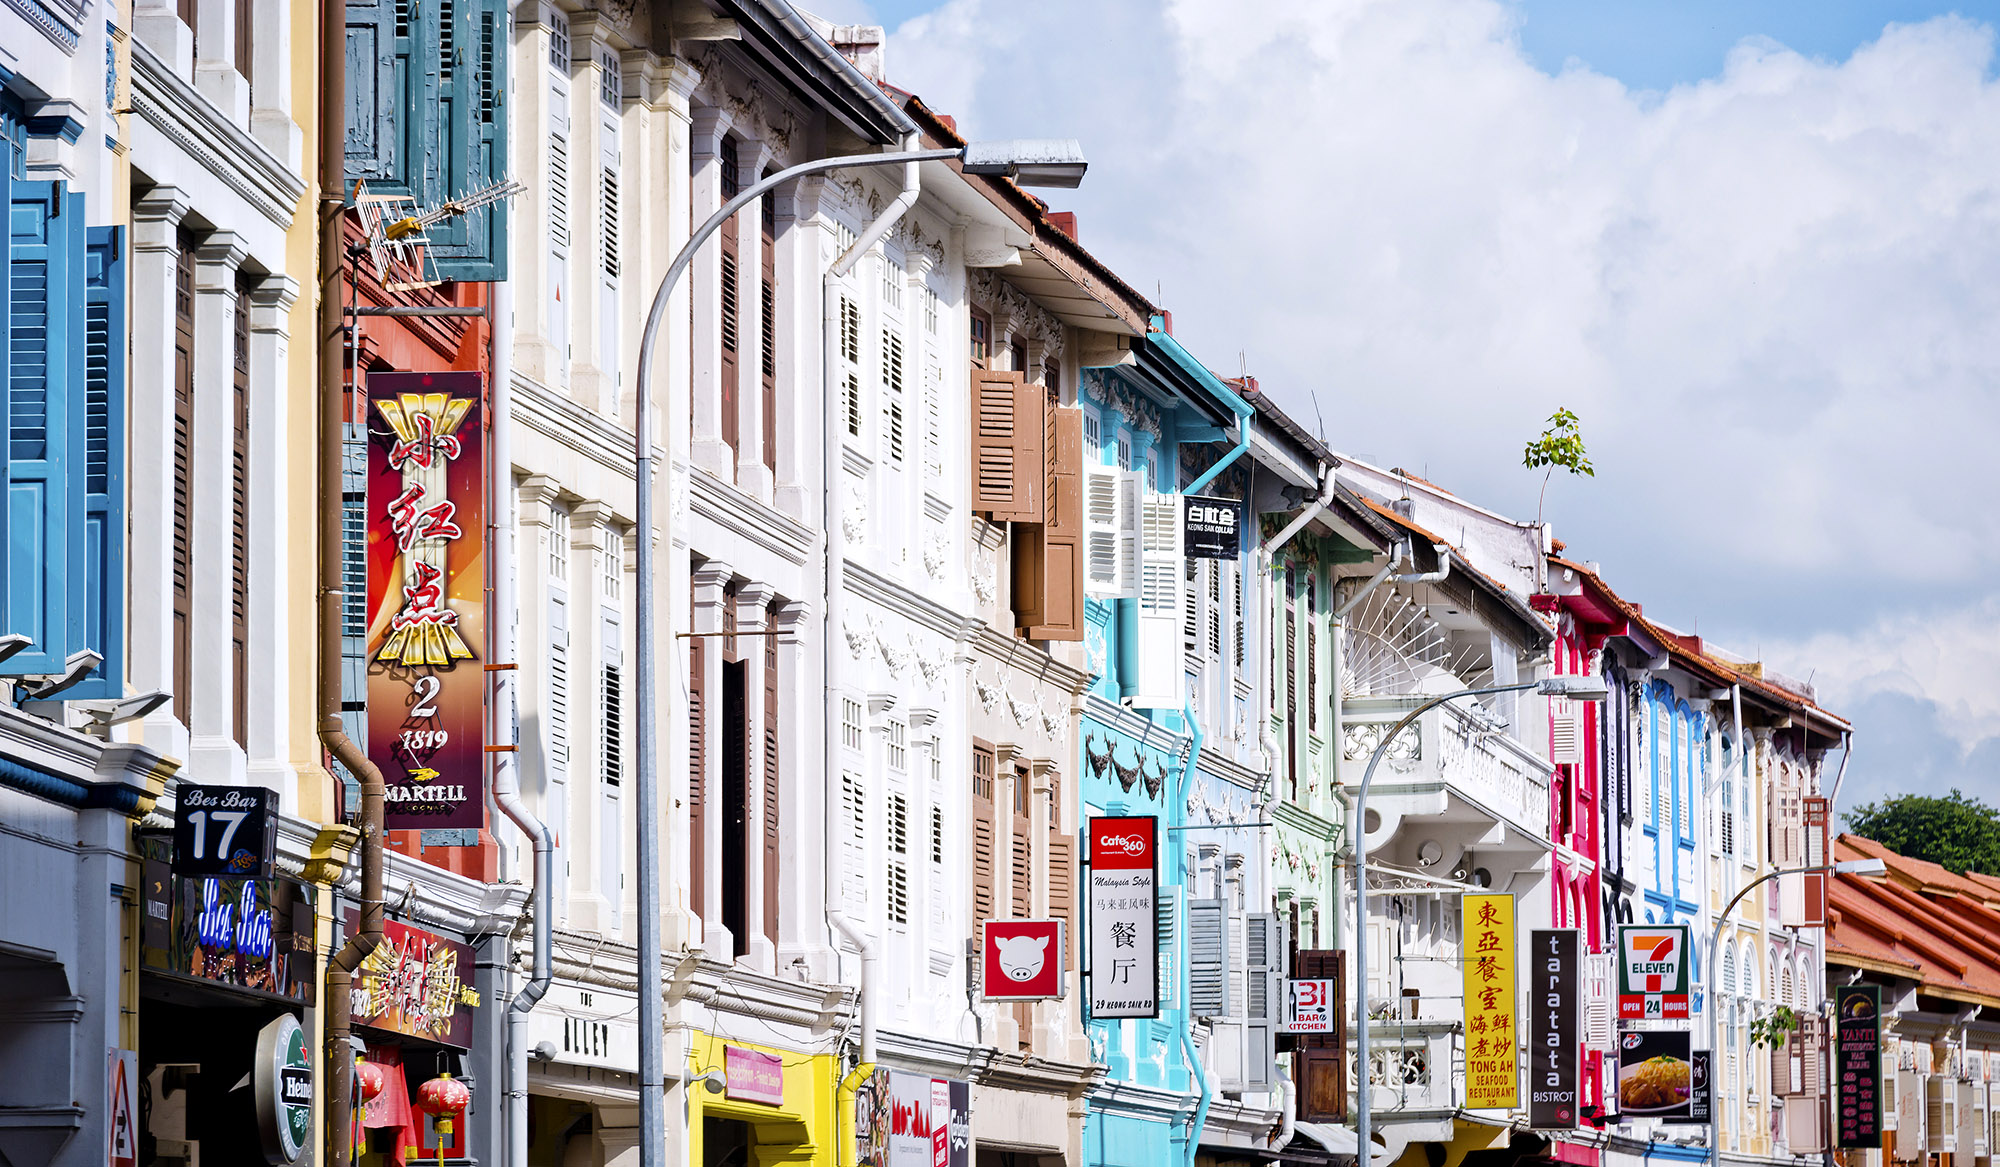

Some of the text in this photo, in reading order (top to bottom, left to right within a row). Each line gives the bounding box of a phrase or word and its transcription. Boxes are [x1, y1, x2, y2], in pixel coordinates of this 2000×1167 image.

[388, 413, 461, 632] 小红点
[1187, 523, 1204, 532] KEONG
[1215, 526, 1234, 535] COLLAB
[411, 675, 441, 718] 2
[403, 730, 449, 750] 1819
[184, 789, 218, 806] Bes
[221, 791, 257, 808] Bar
[384, 785, 467, 803] MARTELL
[188, 810, 250, 860] 17
[1101, 835, 1143, 851] Cafe 360
[229, 853, 257, 869] Tiger
[1094, 876, 1151, 889] Malaysia Style
[1097, 897, 1150, 911] 马来亚风味
[1110, 921, 1136, 985] 餐厅
[1473, 901, 1505, 1011] 東亞餐室
[1632, 936, 1674, 992] 7
[581, 992, 592, 1007] THE
[1096, 1000, 1152, 1010] 29 KEONG SAIK RD
[1623, 1000, 1687, 1013] OPEN 24 HOURS
[1546, 936, 1560, 1087] taratata
[564, 1017, 608, 1058] ALLEY
[1841, 1028, 1875, 1041] YANTI
[1470, 1060, 1513, 1073] TONG AH
[1476, 1075, 1508, 1086] SEAFOOD
[1469, 1087, 1515, 1099] RESTAURANT
[1533, 1091, 1574, 1102] BISTROT
